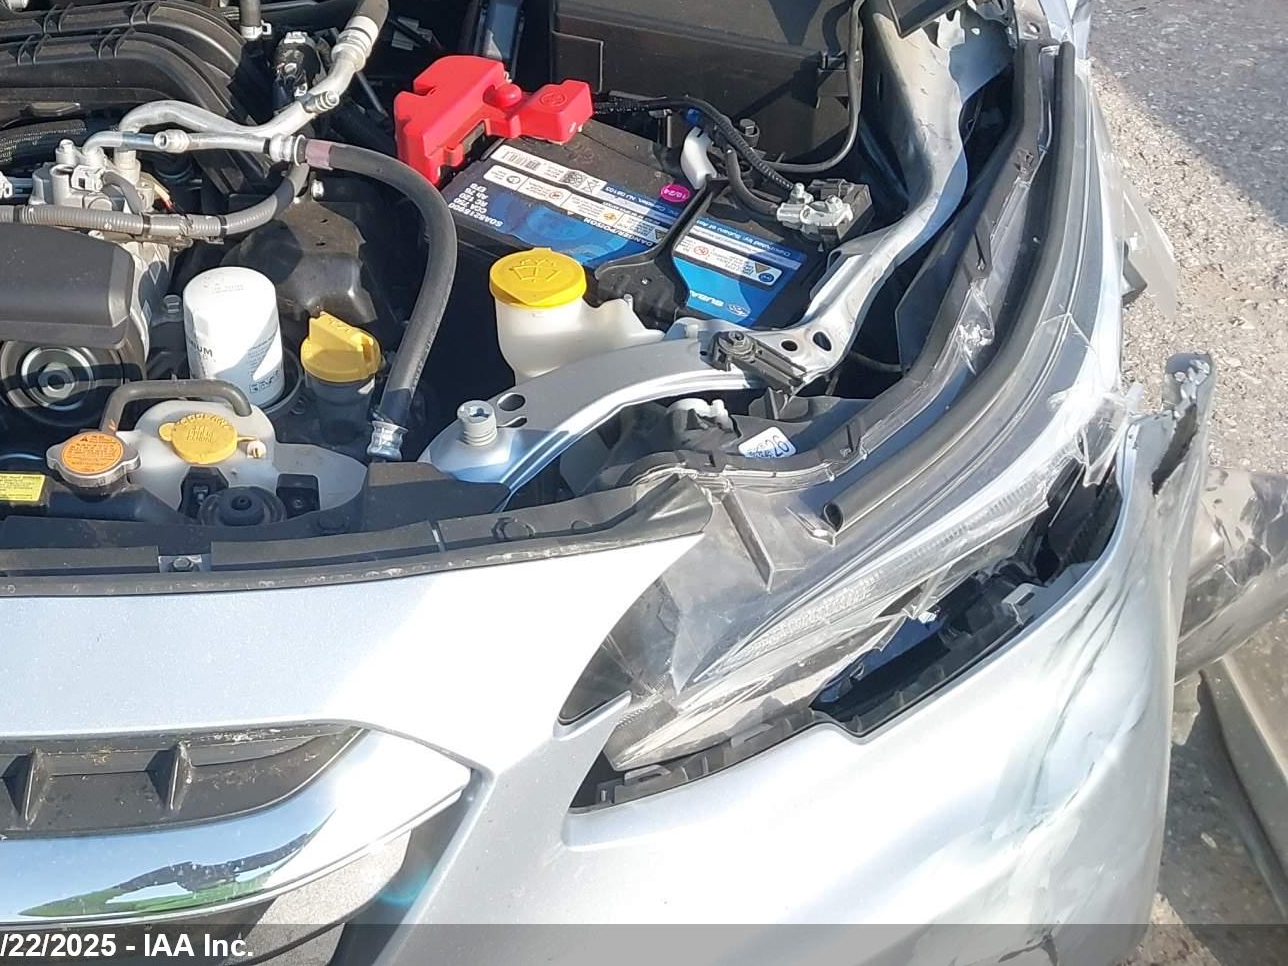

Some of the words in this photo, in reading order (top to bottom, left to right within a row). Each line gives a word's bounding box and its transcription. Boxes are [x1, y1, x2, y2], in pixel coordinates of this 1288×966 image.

[458, 192, 474, 202] 120
[469, 203, 487, 213] CCA
[474, 199, 488, 207] RC
[583, 217, 654, 247] DANGER/POISON
[718, 228, 742, 240] Subaru
[689, 289, 724, 307] SUBA
